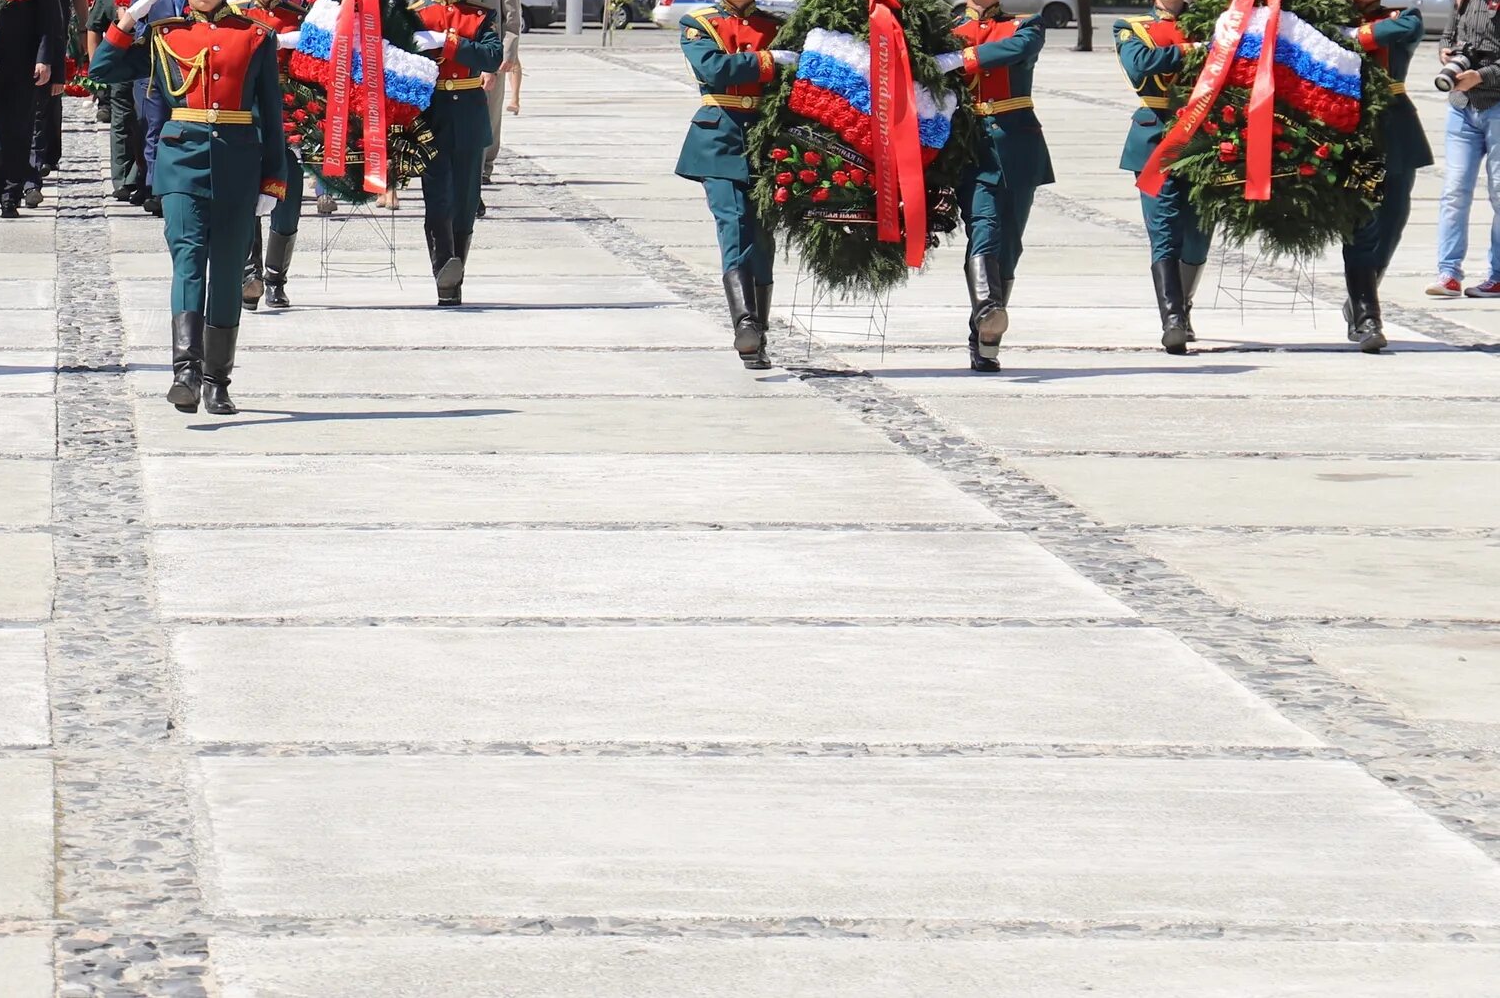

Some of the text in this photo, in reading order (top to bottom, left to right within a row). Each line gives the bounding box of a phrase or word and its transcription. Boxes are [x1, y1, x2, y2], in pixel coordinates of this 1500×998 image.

[364, 14, 375, 31] от
[333, 35, 348, 104] сибирякам
[365, 35, 379, 89] Военного
[368, 91, 379, 133] совета
[326, 114, 343, 167] Воинам
[371, 134, 385, 149] 41
